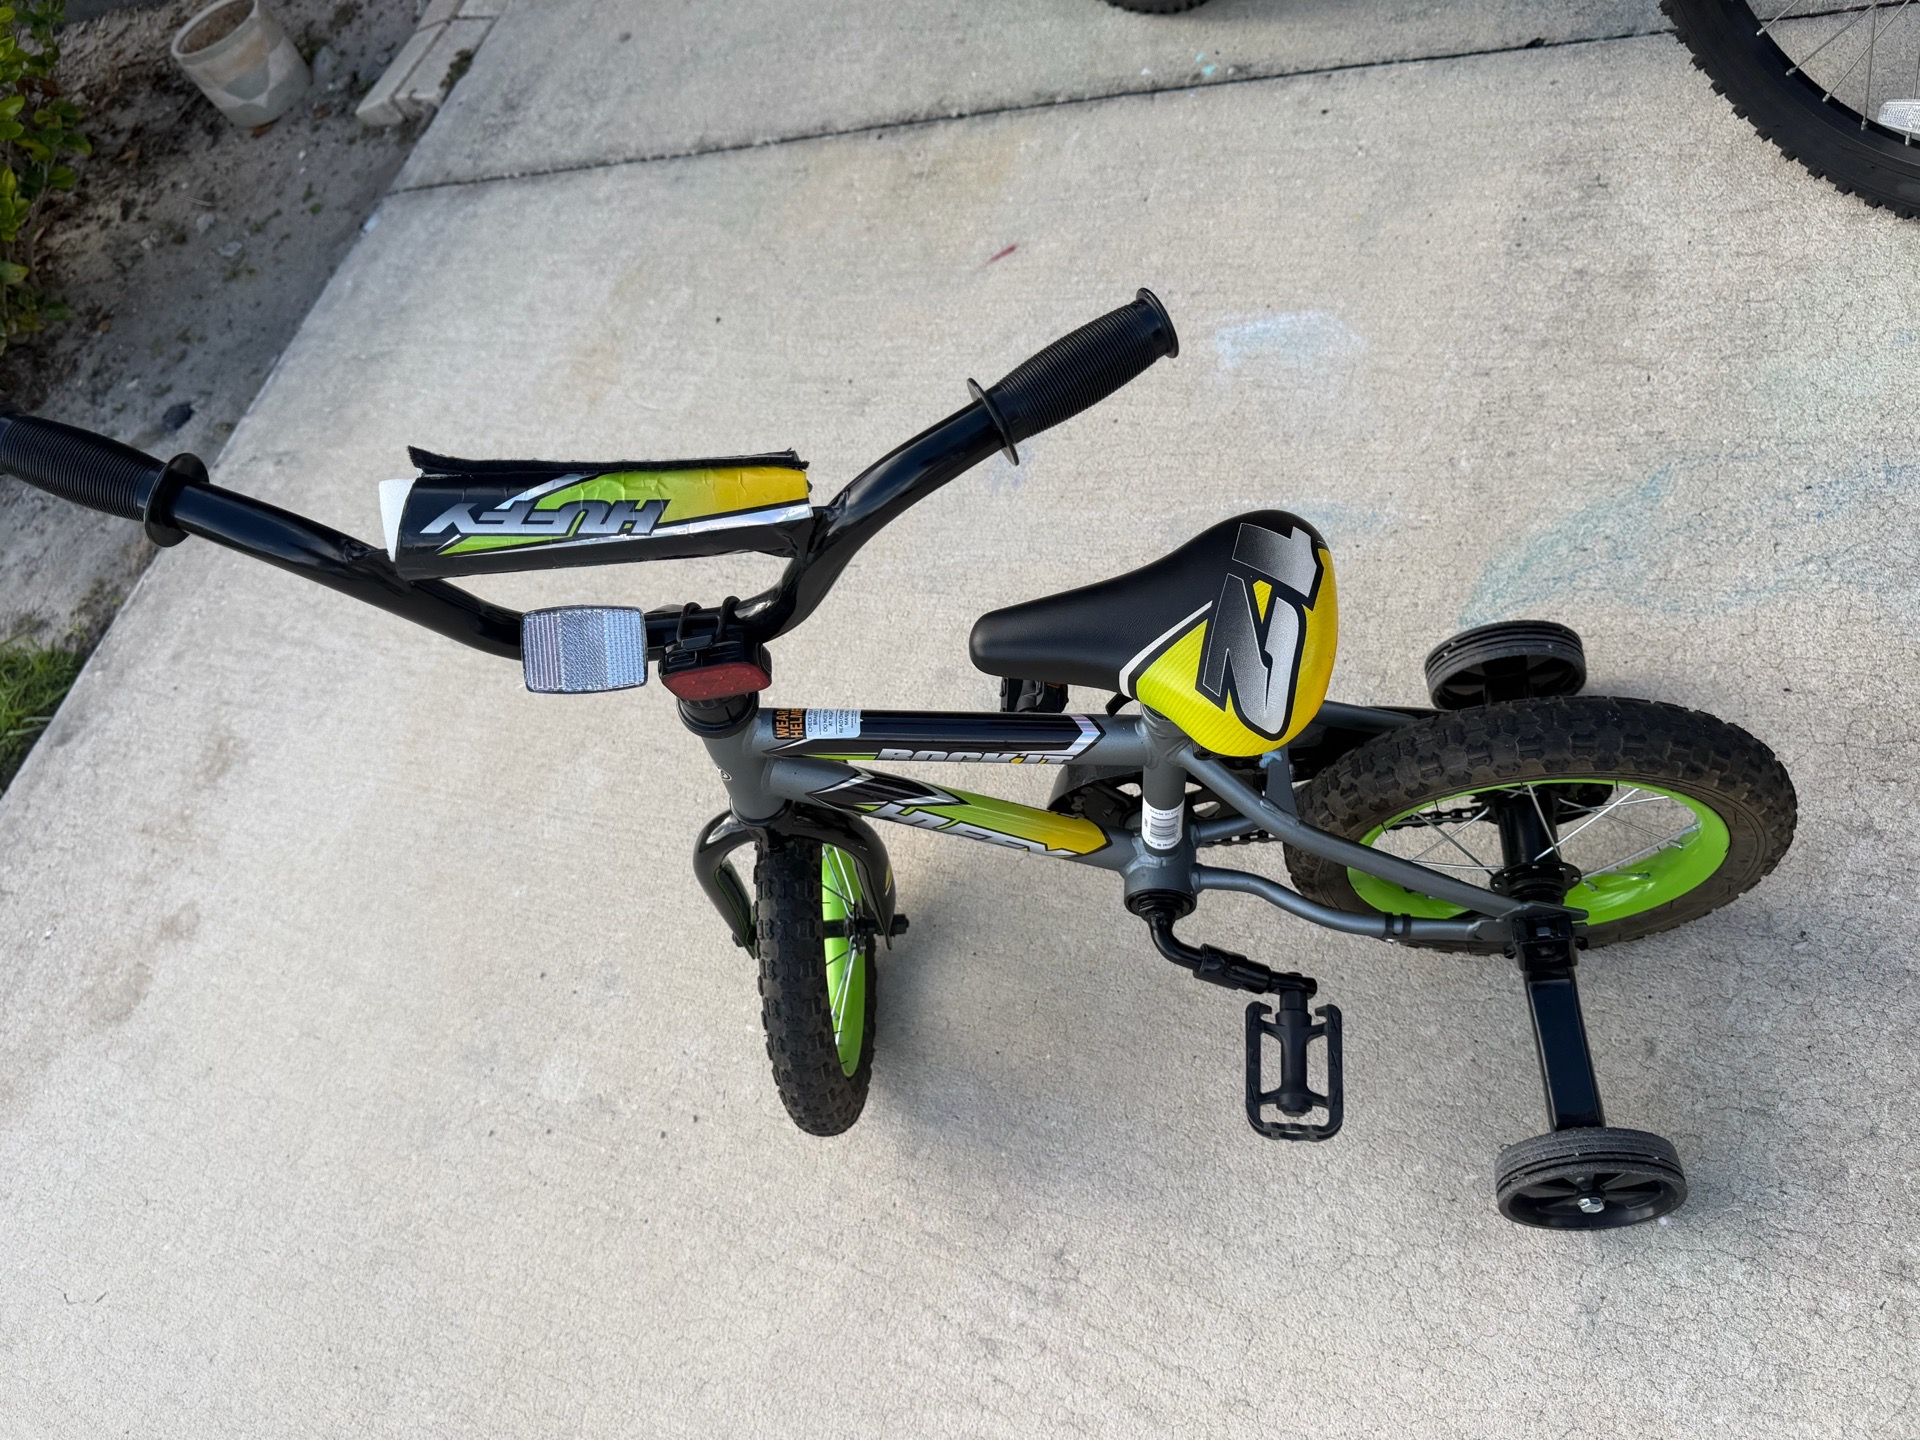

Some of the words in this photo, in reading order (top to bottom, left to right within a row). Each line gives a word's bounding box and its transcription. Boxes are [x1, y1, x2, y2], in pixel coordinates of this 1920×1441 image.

[419, 499, 670, 537] HUFFY
[1203, 523, 1317, 734] 12
[776, 709, 789, 738] WEAR
[790, 708, 803, 738] HELME
